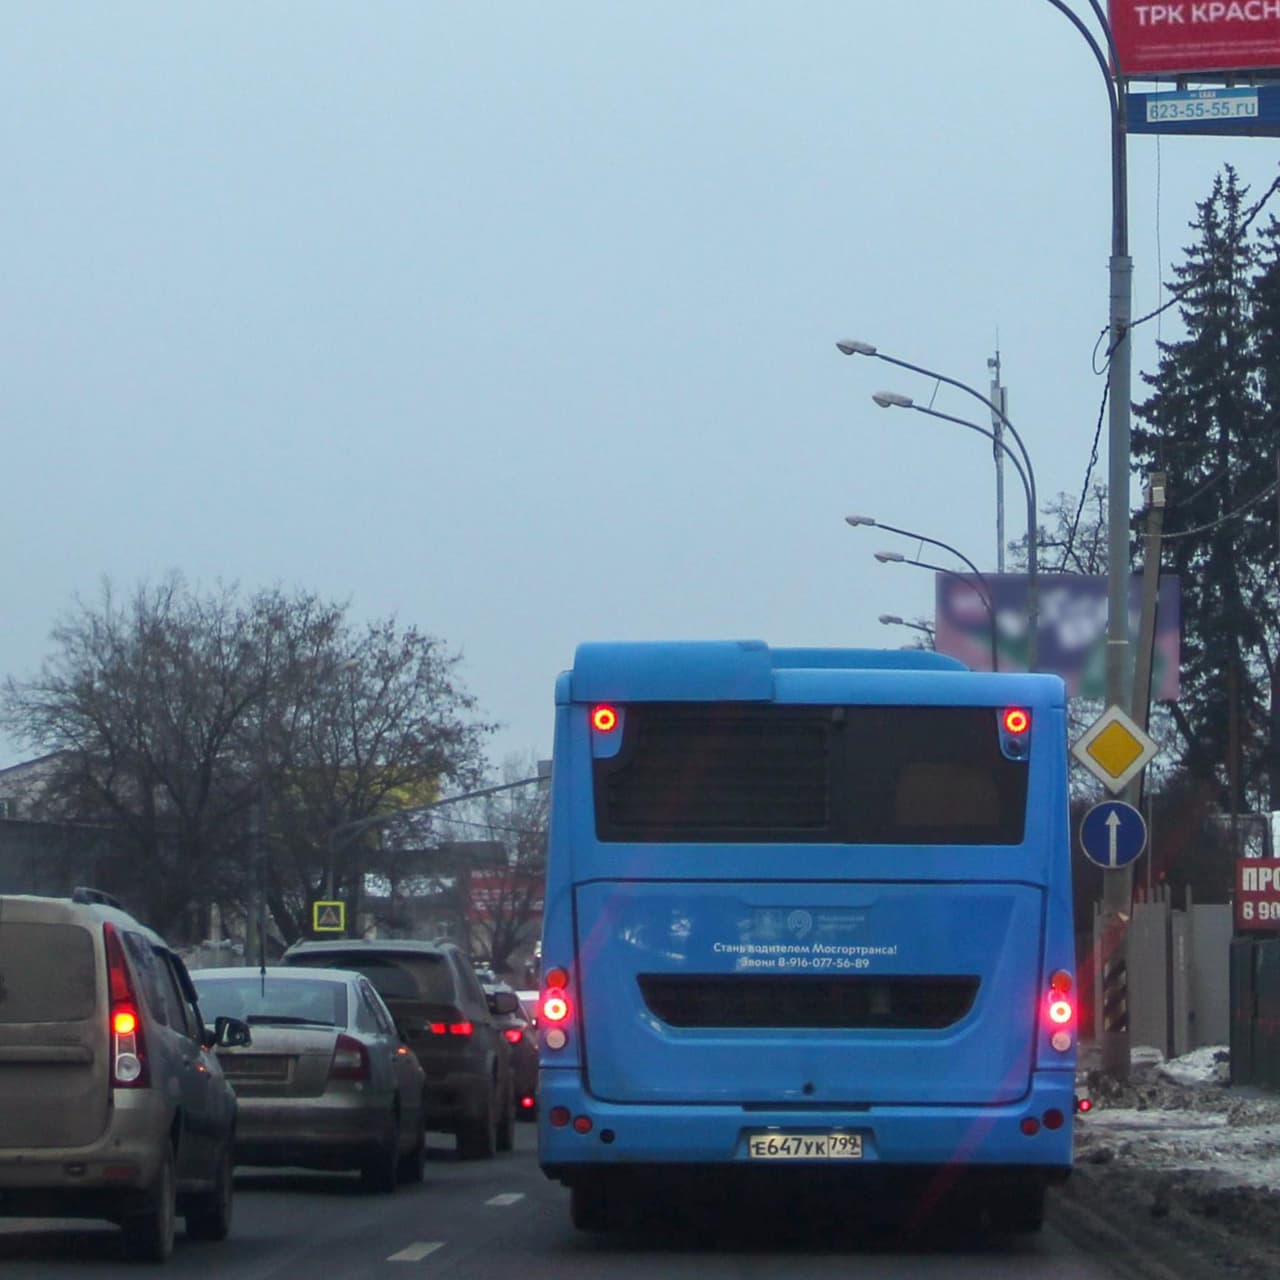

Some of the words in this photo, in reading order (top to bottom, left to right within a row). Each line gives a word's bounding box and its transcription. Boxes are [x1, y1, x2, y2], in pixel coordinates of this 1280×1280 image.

[1134, 5, 1185, 26] ТРК
[1149, 101, 1256, 120] 623-55-55.ru
[713, 942, 745, 953] Стань
[747, 943, 810, 954] водителем
[812, 943, 897, 956] Мосгортранса!
[740, 957, 776, 967] Звони
[778, 957, 870, 968] 8-916-077-56-89
